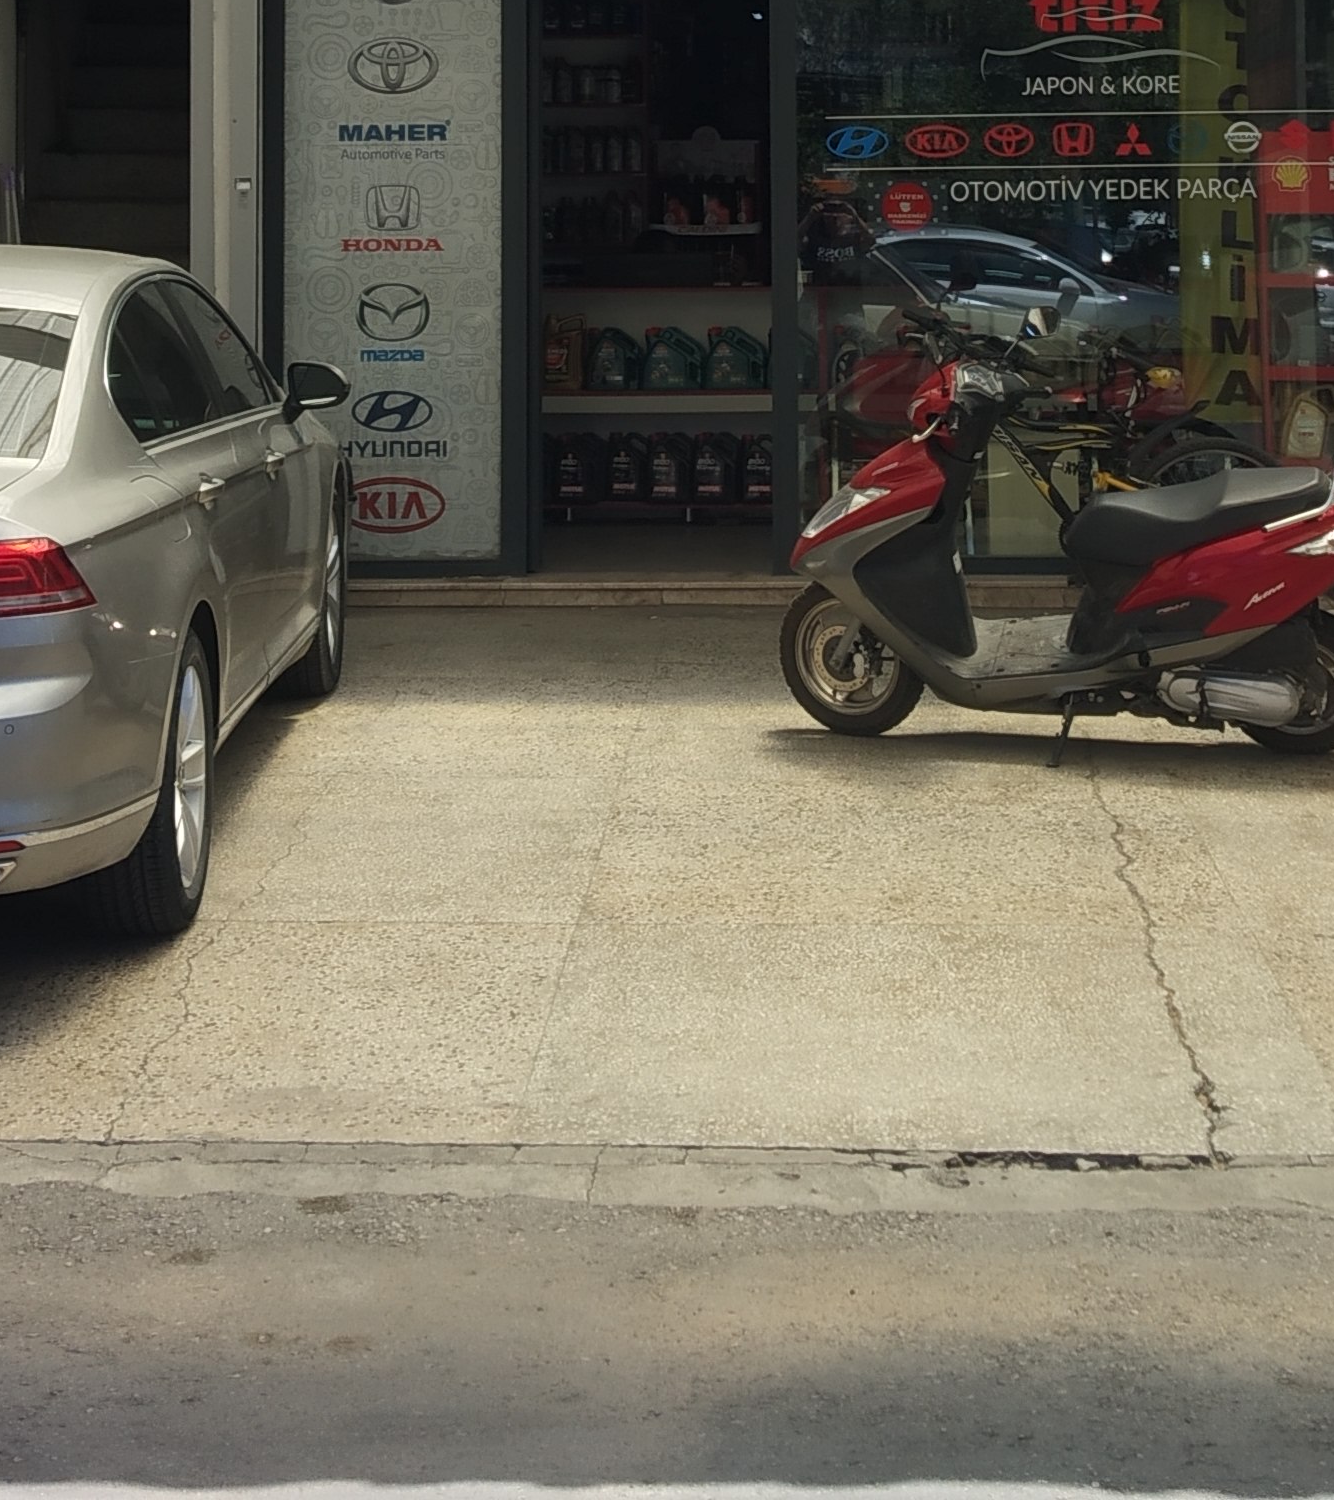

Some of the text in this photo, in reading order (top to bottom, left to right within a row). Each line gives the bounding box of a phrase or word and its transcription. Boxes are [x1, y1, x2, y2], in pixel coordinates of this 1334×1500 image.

[1021, 75, 1180, 96] JAPON & KORE
[338, 124, 448, 143] MAHER
[340, 148, 445, 161] Automotive Parts
[950, 174, 1257, 205] OTOMOTİV YEDEK PARÇA
[341, 238, 444, 252] HONDA
[360, 349, 425, 362] mazda
[342, 440, 448, 459] HYUNDAI
